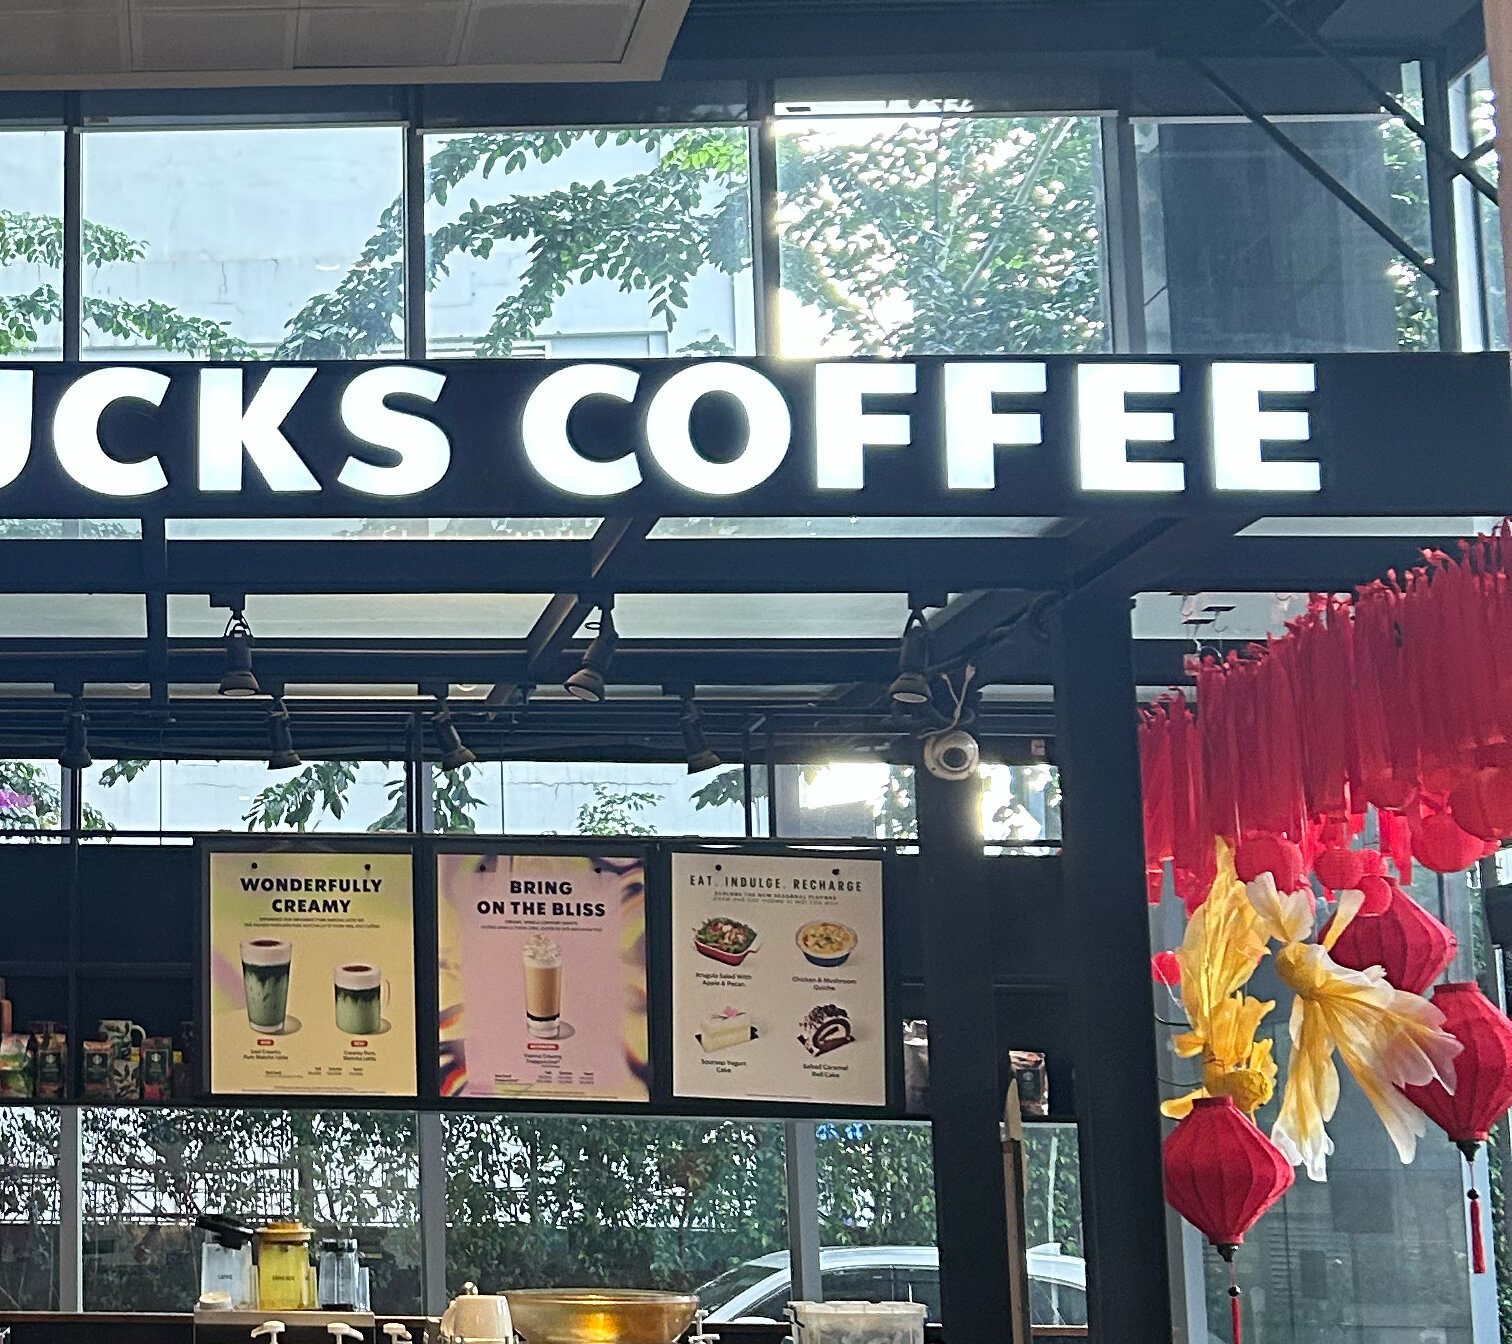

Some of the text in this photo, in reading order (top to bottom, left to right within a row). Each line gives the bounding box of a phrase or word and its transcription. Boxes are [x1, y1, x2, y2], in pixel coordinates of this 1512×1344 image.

[521, 361, 1322, 497] COFFEE
[239, 877, 383, 893] WONDERFULLY
[510, 880, 573, 895] BRING
[793, 878, 863, 892] RECHARGE
[271, 899, 351, 913] CREAMY
[476, 900, 606, 917] ON THE BLISS
